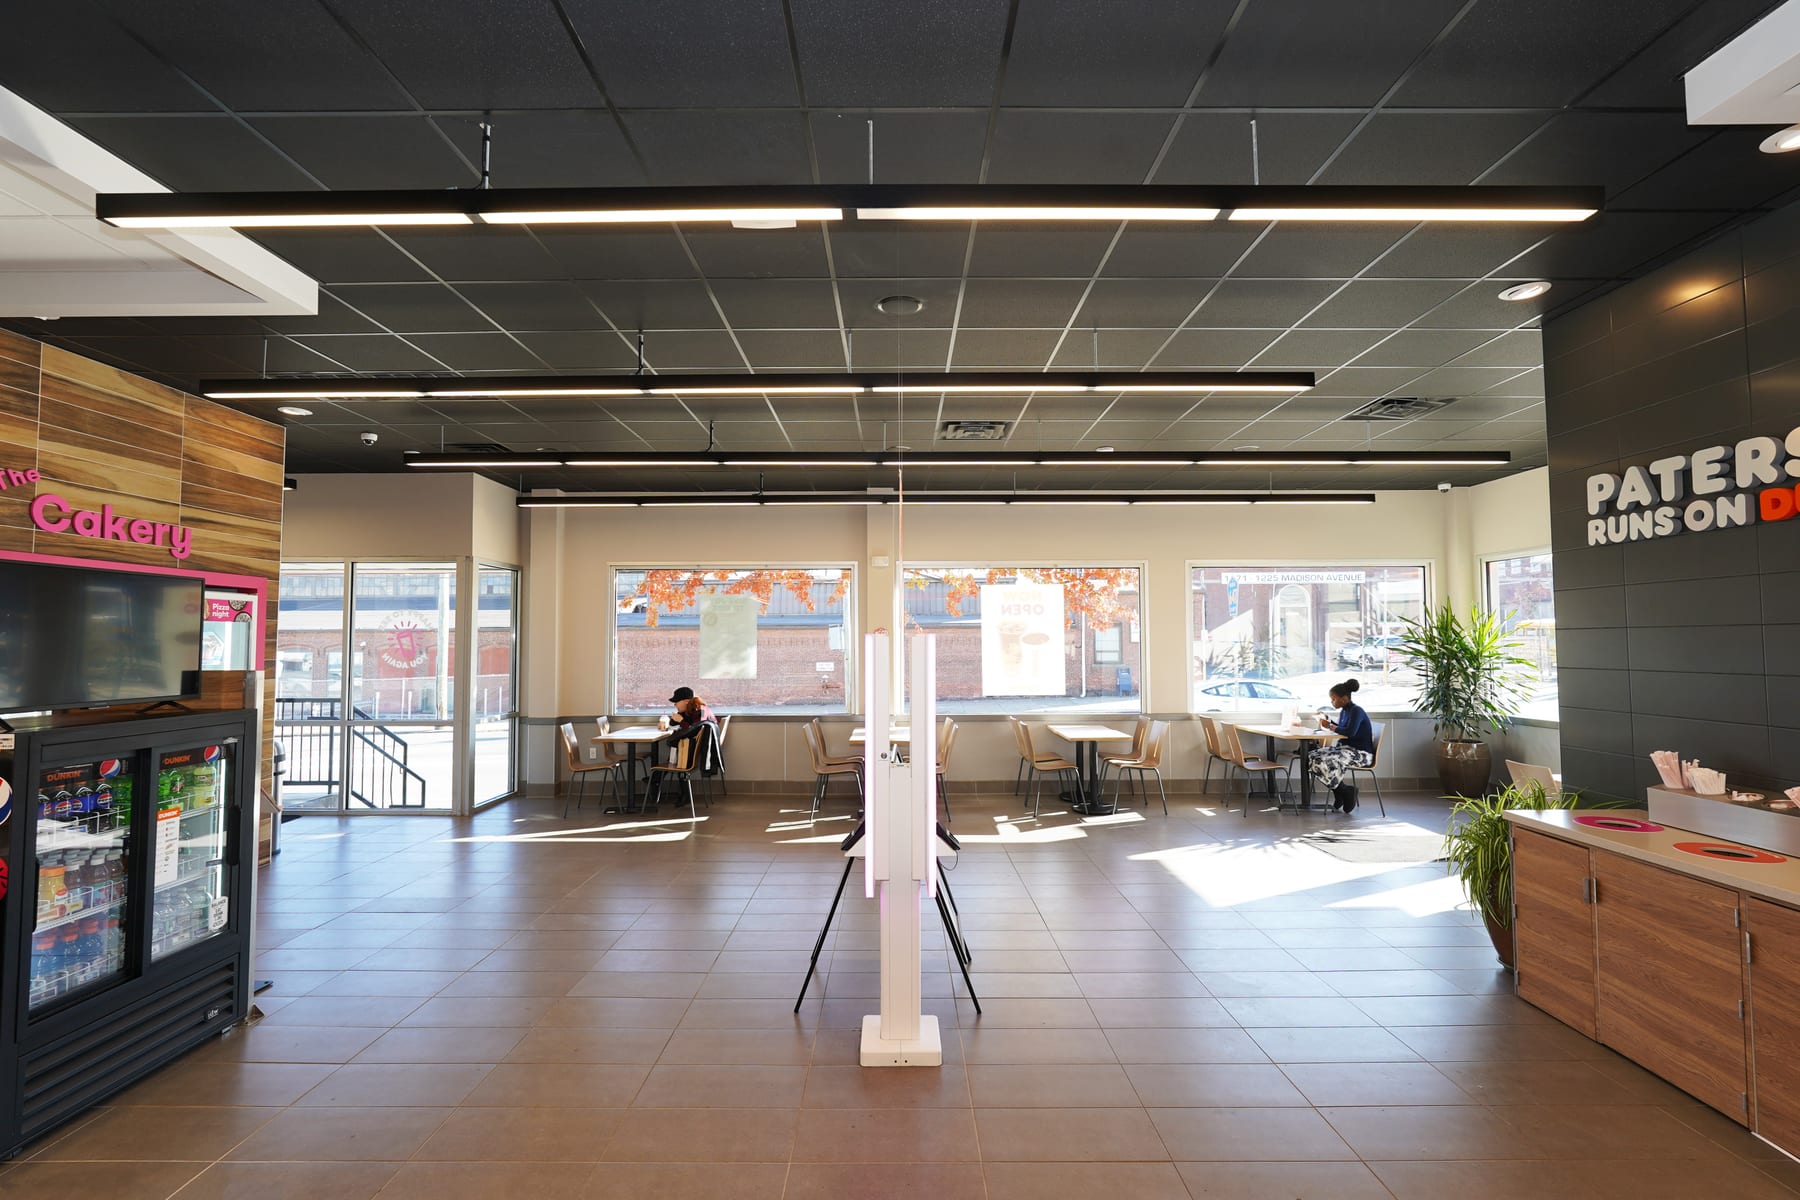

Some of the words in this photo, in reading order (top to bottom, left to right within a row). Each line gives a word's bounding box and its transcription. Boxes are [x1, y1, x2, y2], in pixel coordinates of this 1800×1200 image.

[0, 468, 41, 490] The
[30, 493, 192, 559] Cakery
[1587, 506, 1683, 546] RUNS
[1684, 493, 1756, 532] ON
[1281, 574, 1324, 582] MADISON
[1326, 574, 1363, 582] AVENUE
[212, 603, 230, 611] Pizza
